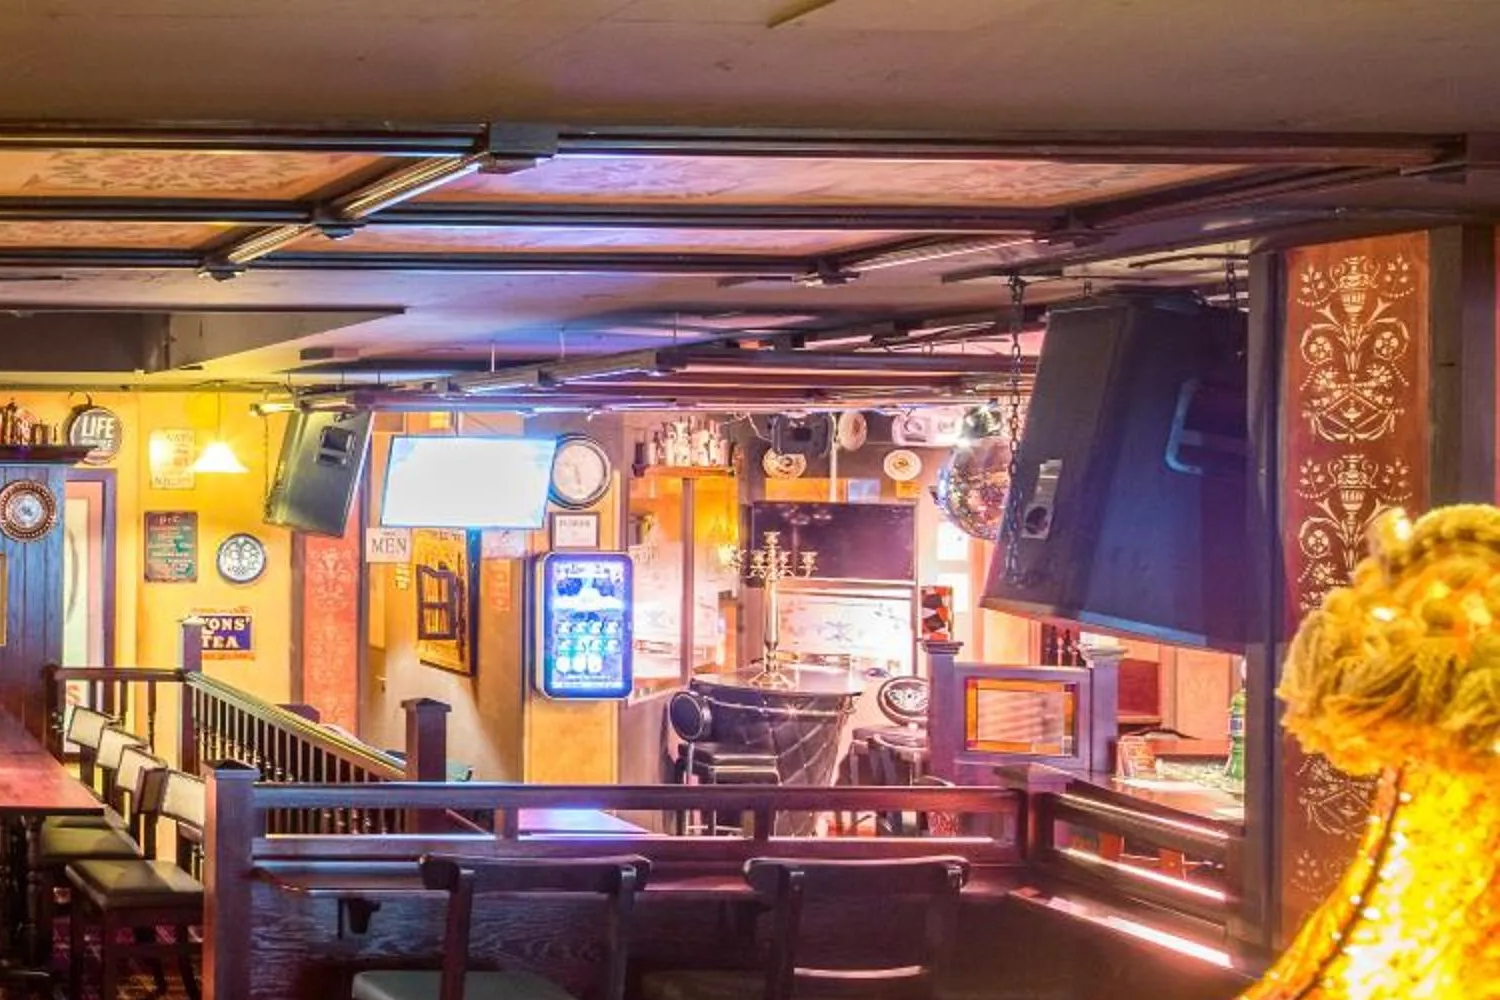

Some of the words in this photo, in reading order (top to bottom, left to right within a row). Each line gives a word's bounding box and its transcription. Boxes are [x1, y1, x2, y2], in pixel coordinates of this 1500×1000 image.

[82, 415, 115, 439] LIFE
[371, 538, 408, 555] MEN
[201, 635, 241, 649] TEA
